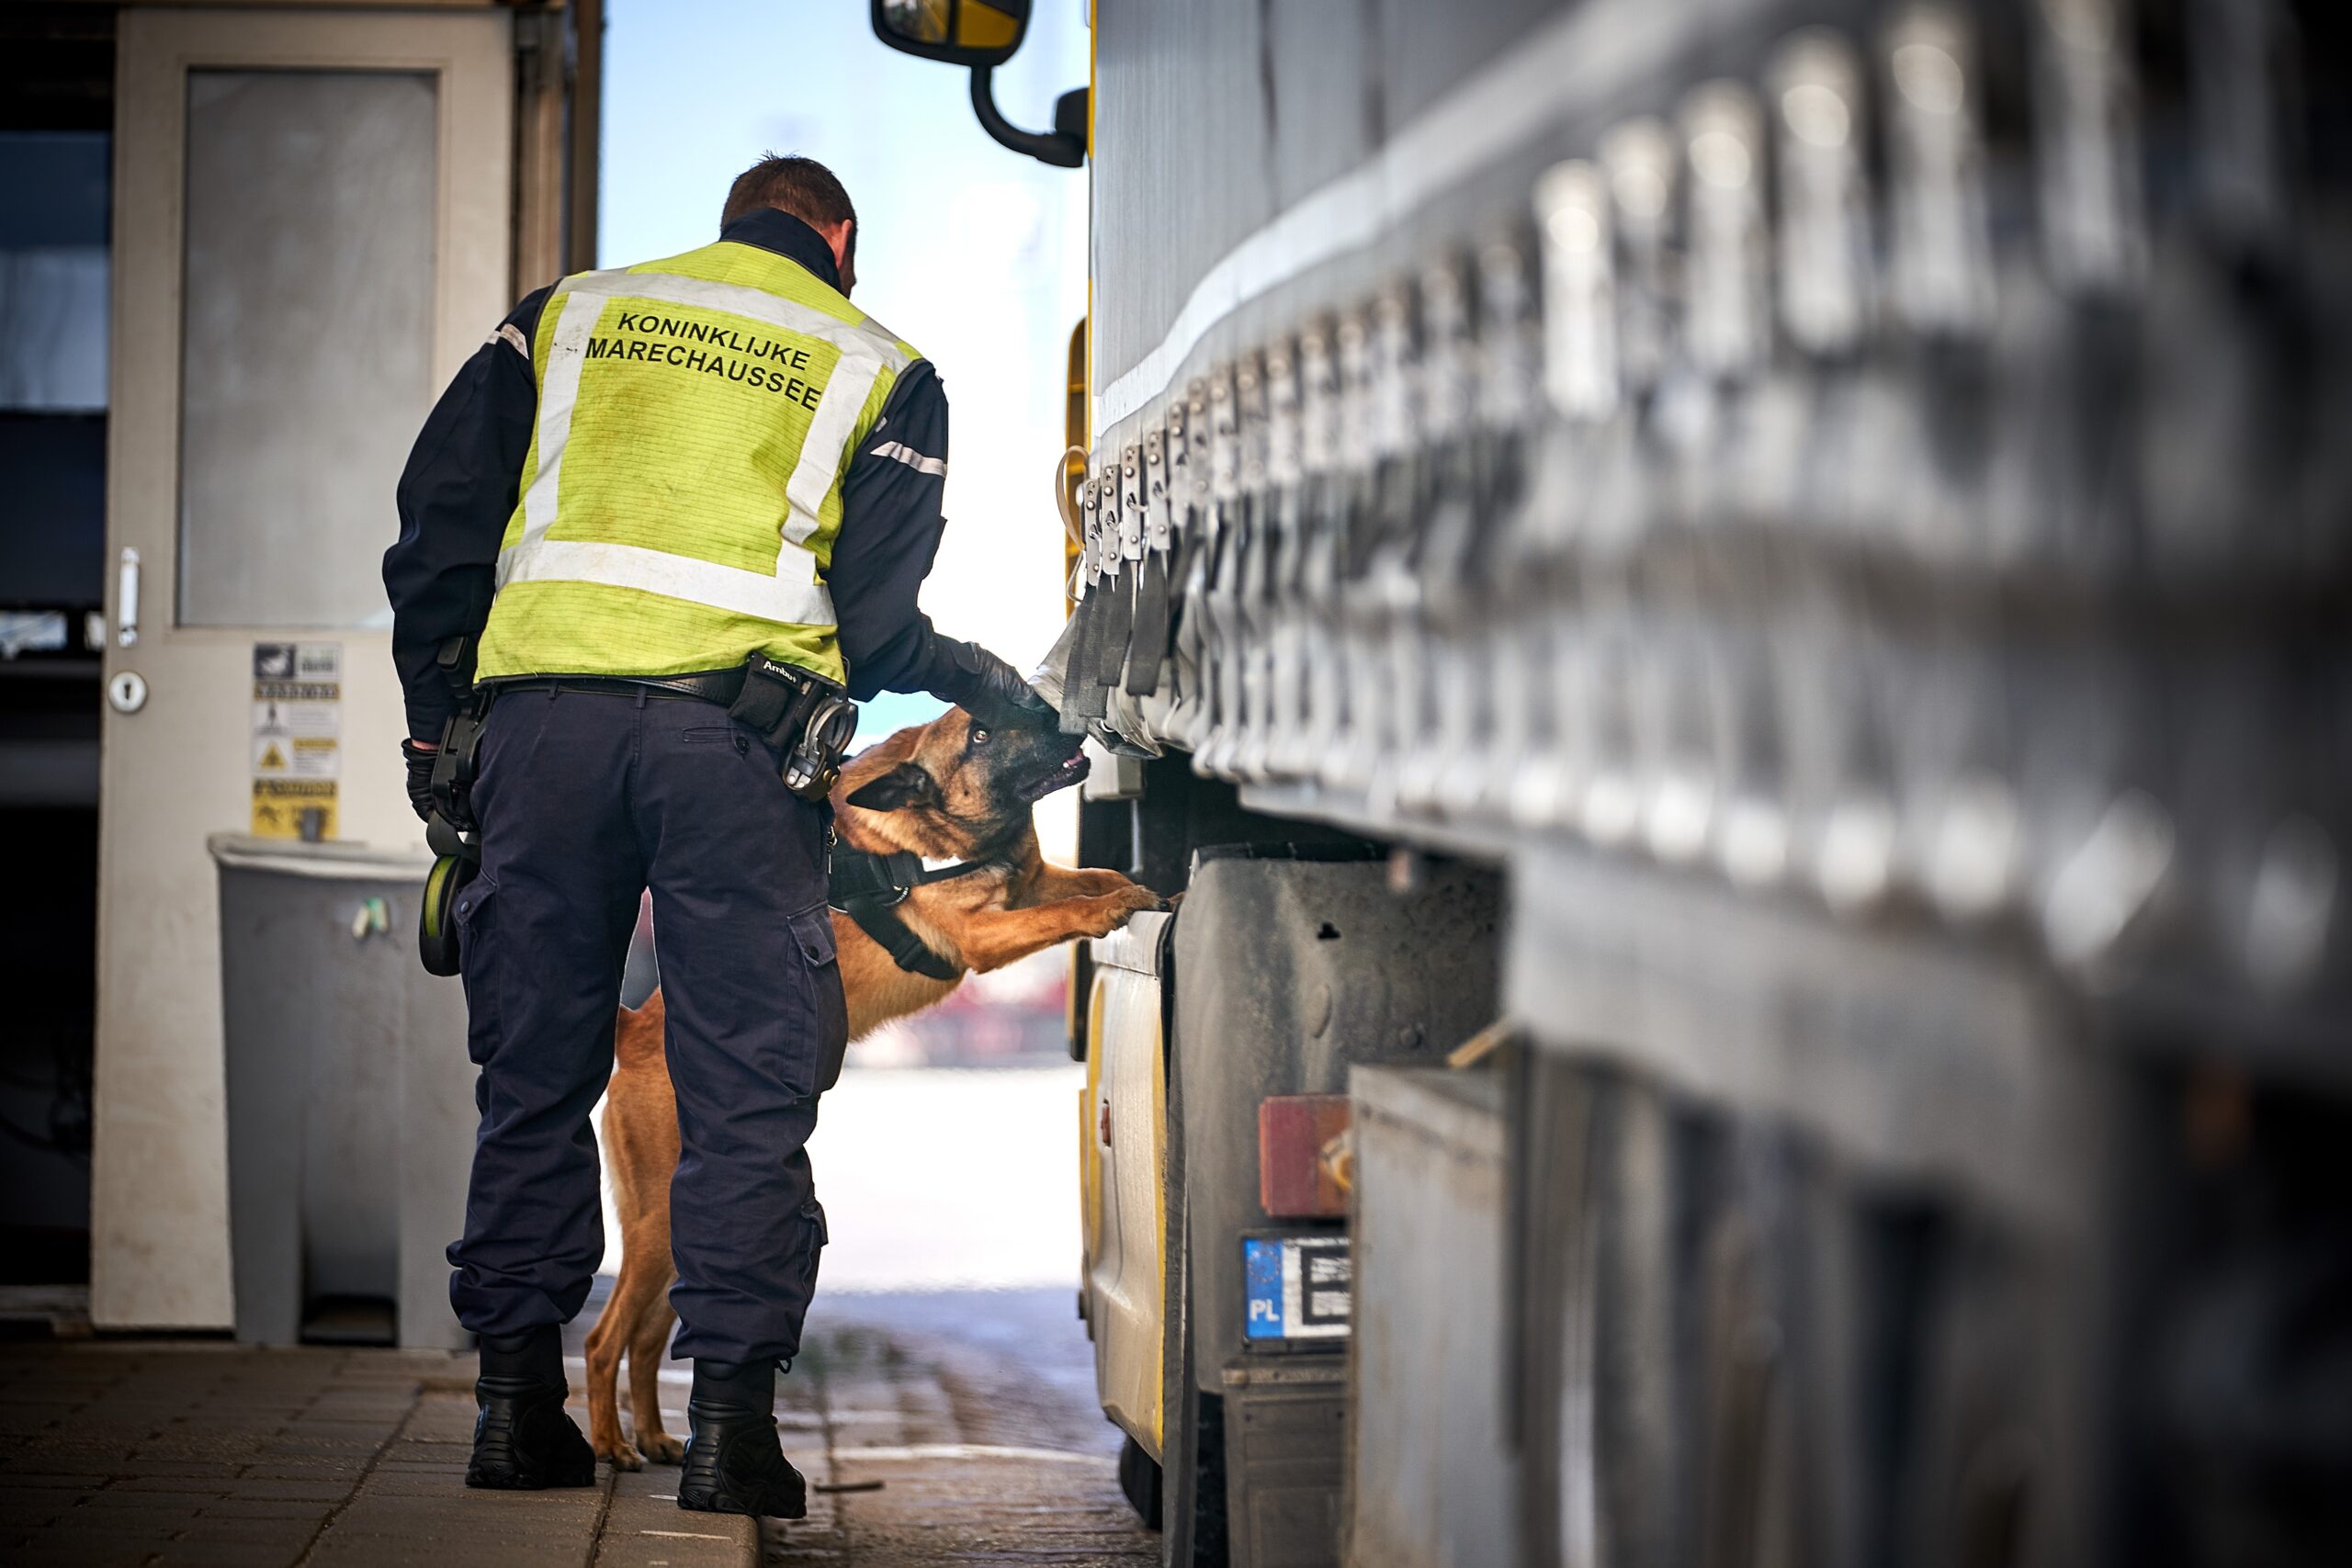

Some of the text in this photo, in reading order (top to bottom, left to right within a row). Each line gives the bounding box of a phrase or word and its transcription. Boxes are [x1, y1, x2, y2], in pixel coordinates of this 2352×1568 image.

[617, 312, 810, 371] KONINKLIJKE
[585, 337, 821, 412] MARECHAUSSEE
[1250, 1299, 1280, 1322] PL
